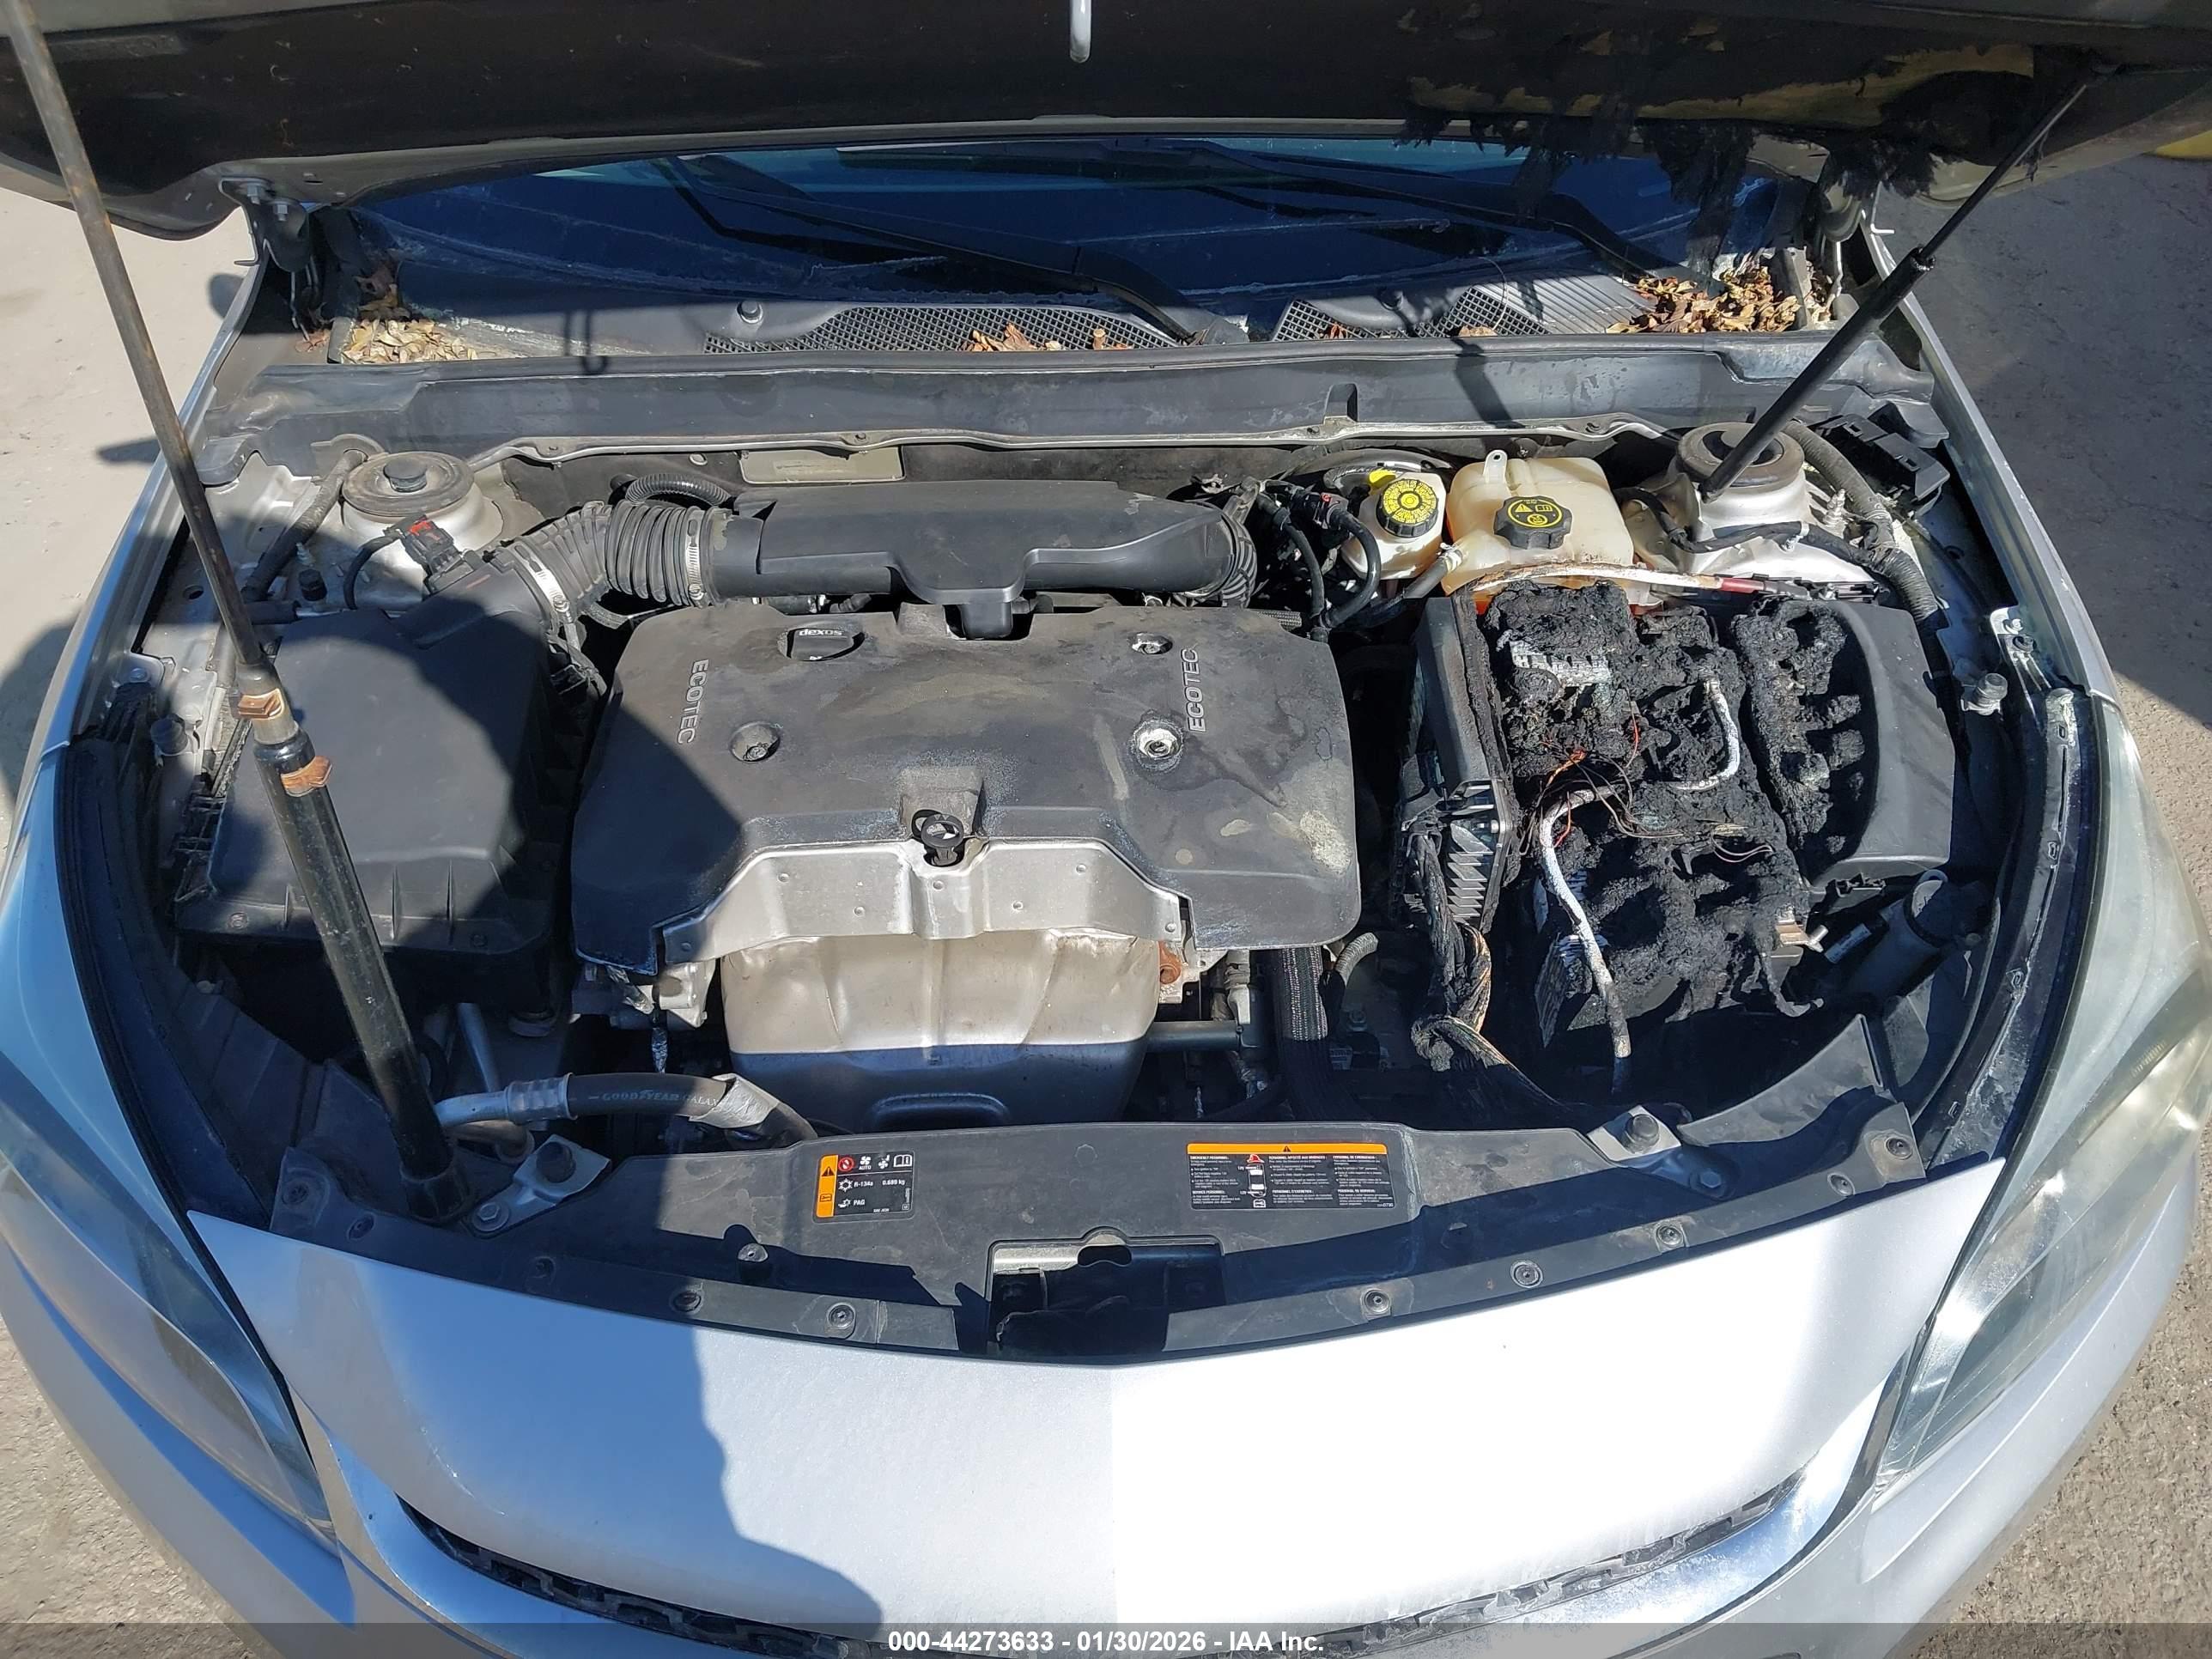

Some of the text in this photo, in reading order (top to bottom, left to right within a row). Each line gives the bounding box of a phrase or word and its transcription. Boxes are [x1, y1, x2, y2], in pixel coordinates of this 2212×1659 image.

[799, 628, 844, 636] dexos
[677, 659, 709, 744] ECOTEC
[1181, 648, 1206, 732] ECOTEC
